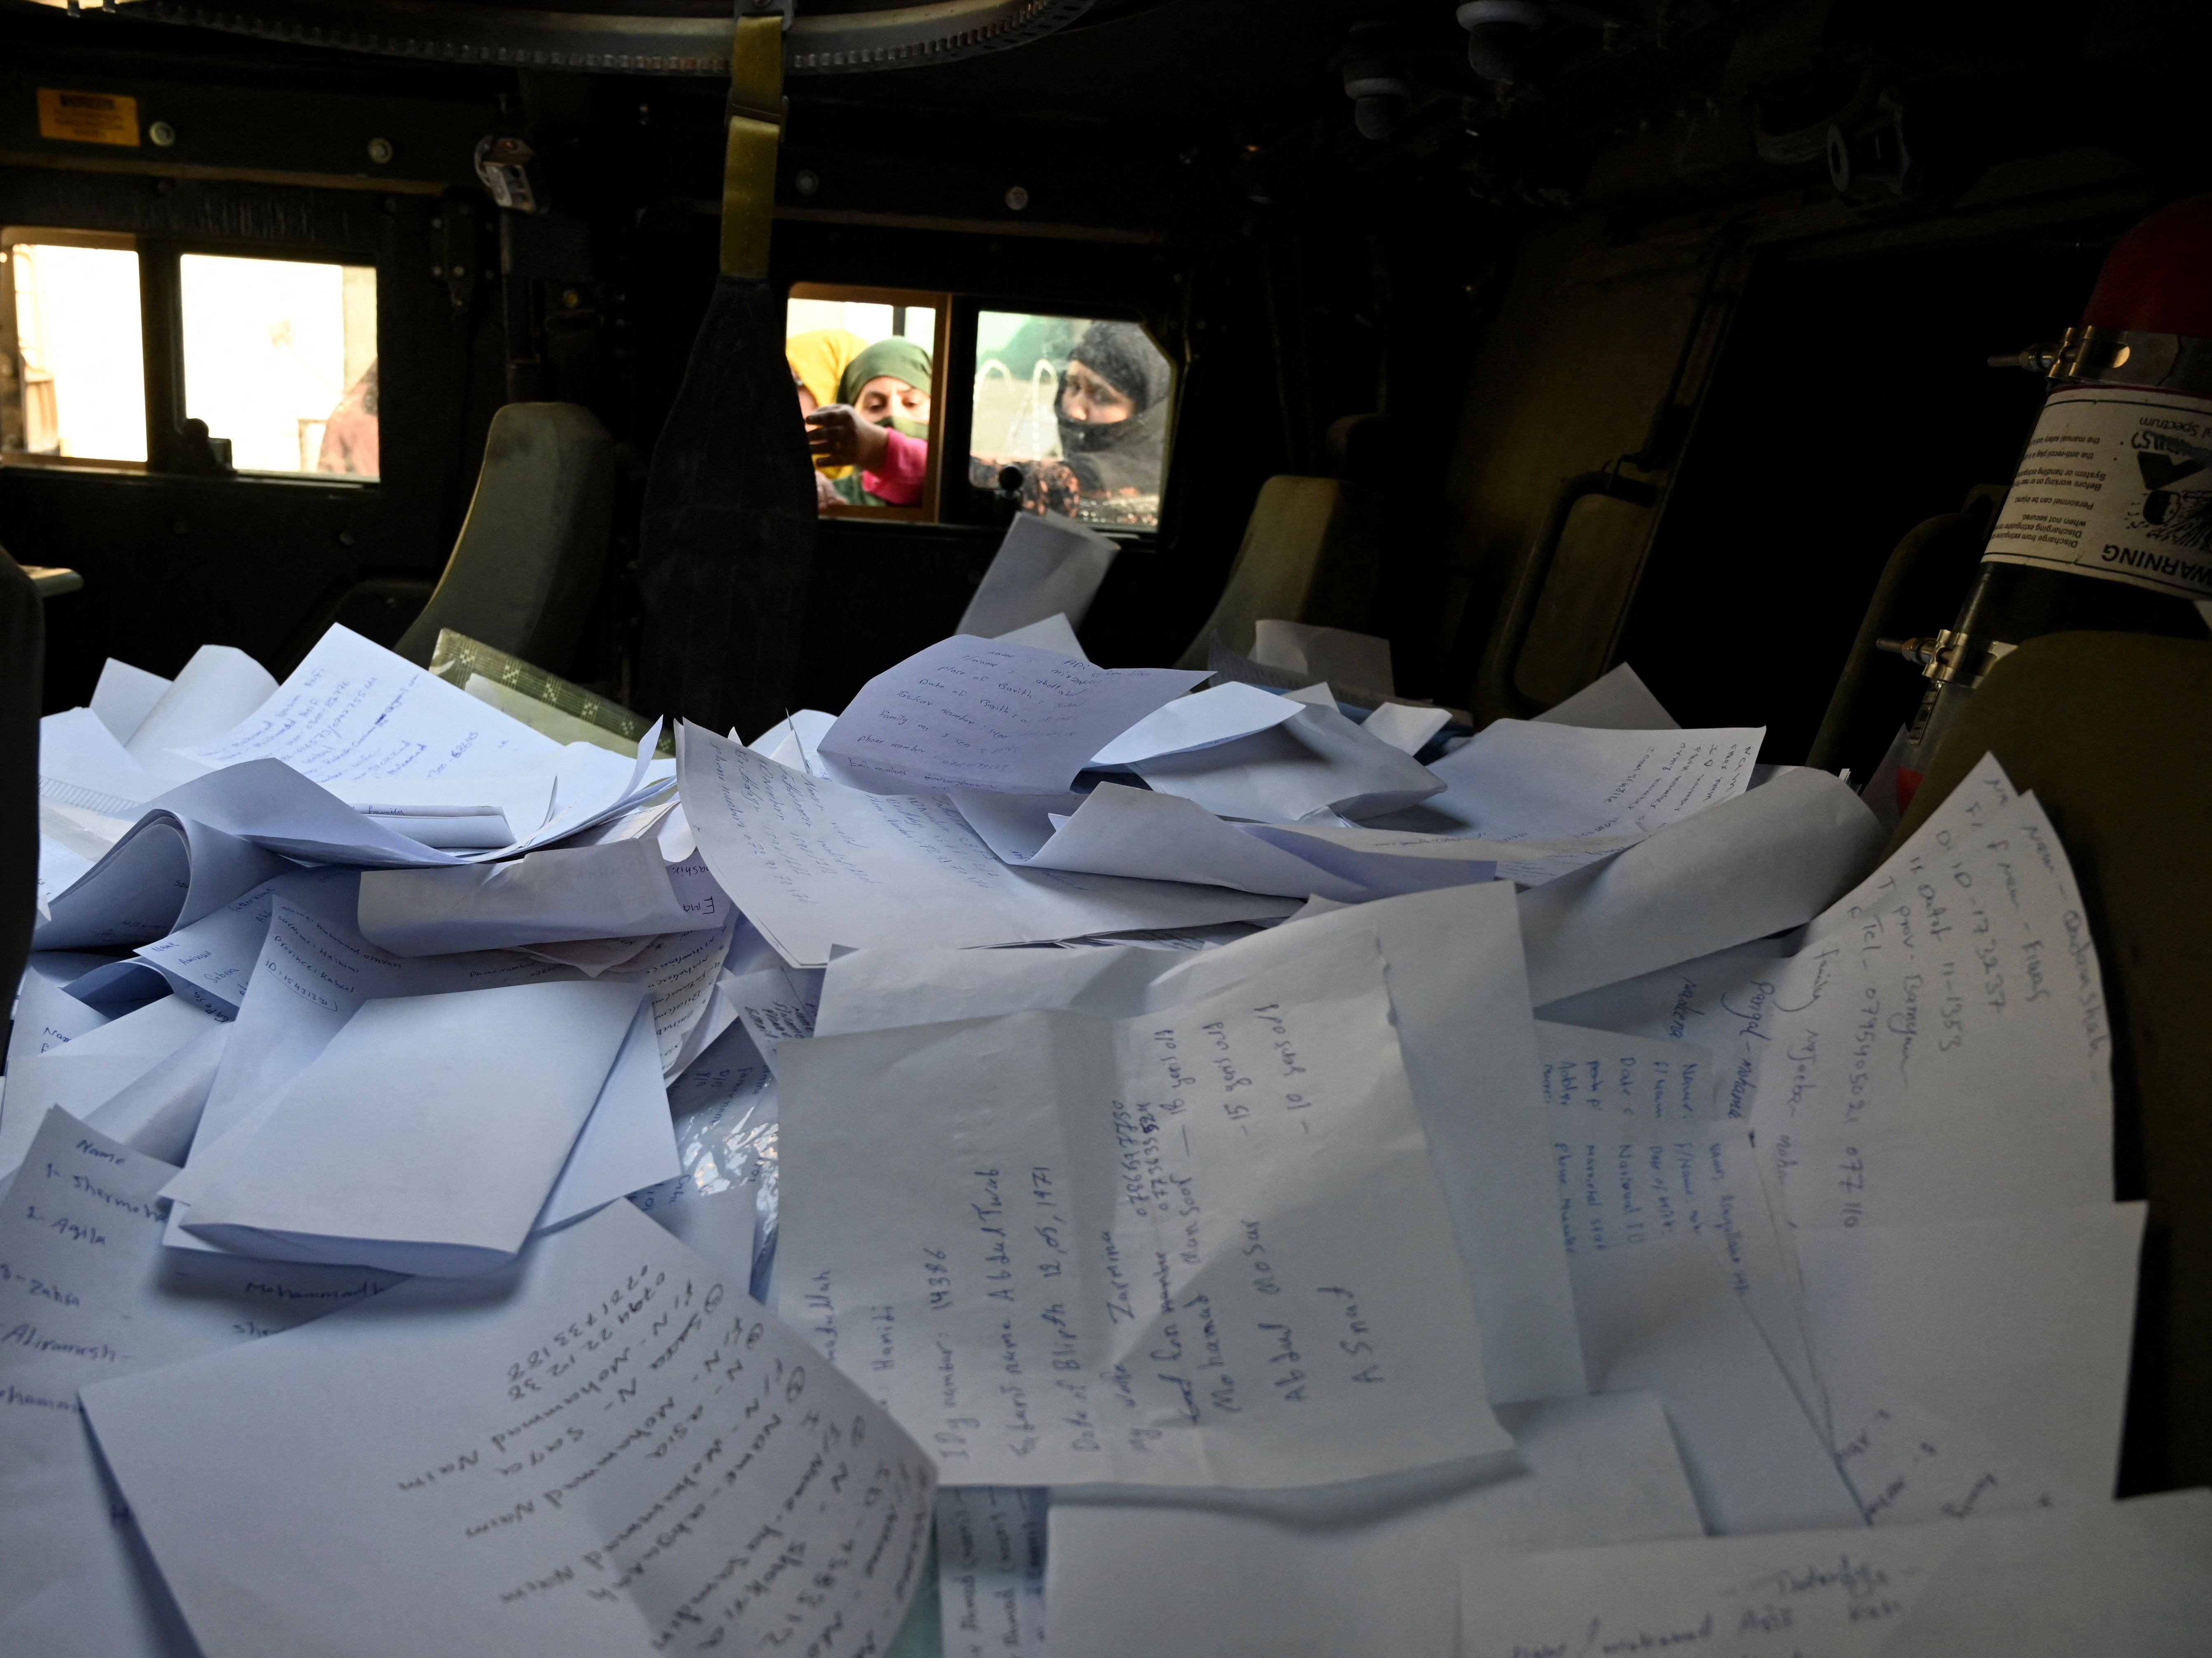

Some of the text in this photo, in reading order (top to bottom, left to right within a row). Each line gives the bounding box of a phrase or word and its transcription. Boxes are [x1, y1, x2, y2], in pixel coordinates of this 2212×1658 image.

[2139, 415, 2200, 436] Spectrum
[2060, 434, 2086, 445] manual
[2086, 436, 2100, 445] the
[2081, 452, 2094, 460] the
[2037, 466, 2063, 477] handling
[2075, 468, 2106, 481] System
[2044, 476, 2072, 489] working
[2074, 480, 2102, 492] Before
[2040, 496, 2052, 504] can
[2053, 497, 2094, 511] Personnel
[2048, 516, 2062, 525] not
[2064, 518, 2086, 527] when
[2035, 523, 2082, 539] Discharging
[2021, 533, 2037, 543] from
[2037, 534, 2079, 548] Discharge
[2100, 543, 2212, 585] WARNING
